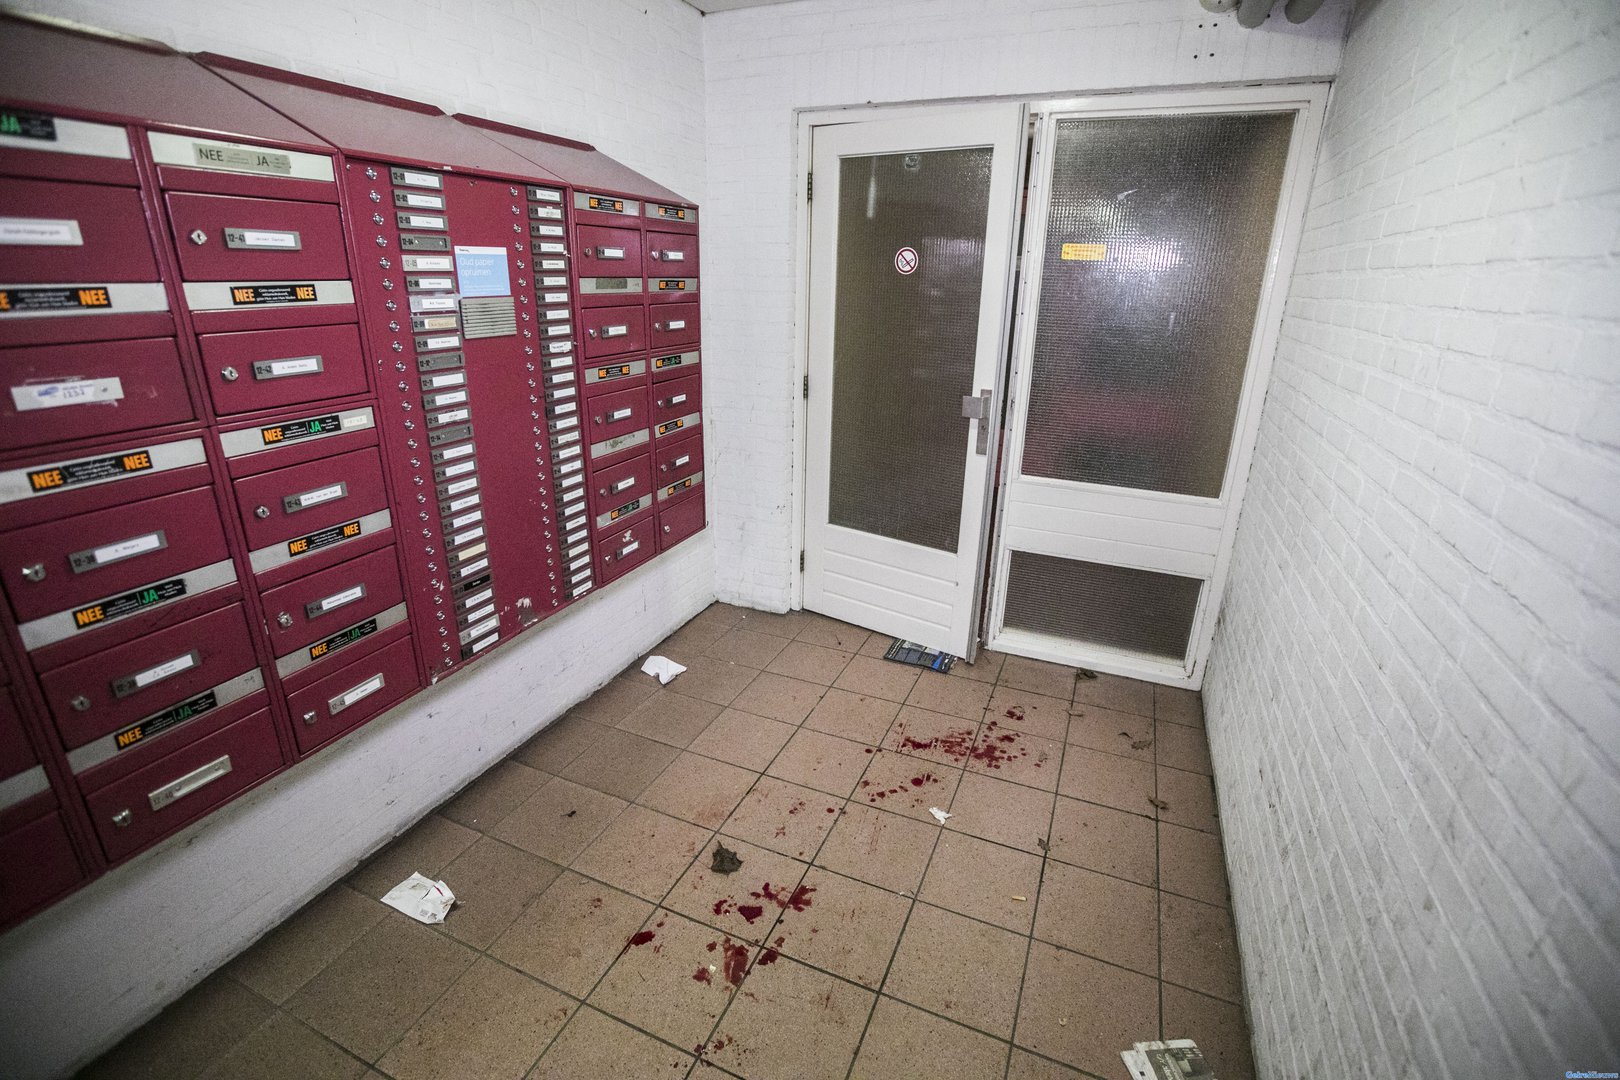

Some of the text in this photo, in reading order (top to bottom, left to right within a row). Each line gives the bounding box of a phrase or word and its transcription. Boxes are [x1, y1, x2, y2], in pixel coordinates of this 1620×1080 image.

[198, 148, 224, 162] NEE
[256, 155, 270, 167] JA
[460, 258, 494, 268] Oud papier
[462, 269, 491, 277] opruimen
[78, 289, 108, 306] NEE
[234, 288, 256, 302] NEE
[296, 287, 315, 300] NEE
[309, 420, 322, 433] JA
[263, 428, 284, 443] NEE
[123, 453, 150, 471] NEE
[32, 470, 64, 489] NEE
[343, 523, 359, 537] NEE
[289, 539, 308, 554] NEE
[141, 588, 159, 604] JA
[75, 606, 105, 626] NEE
[350, 628, 361, 640] JA
[311, 642, 328, 657] NEE
[177, 705, 193, 720] JA
[118, 727, 143, 747] NEE
